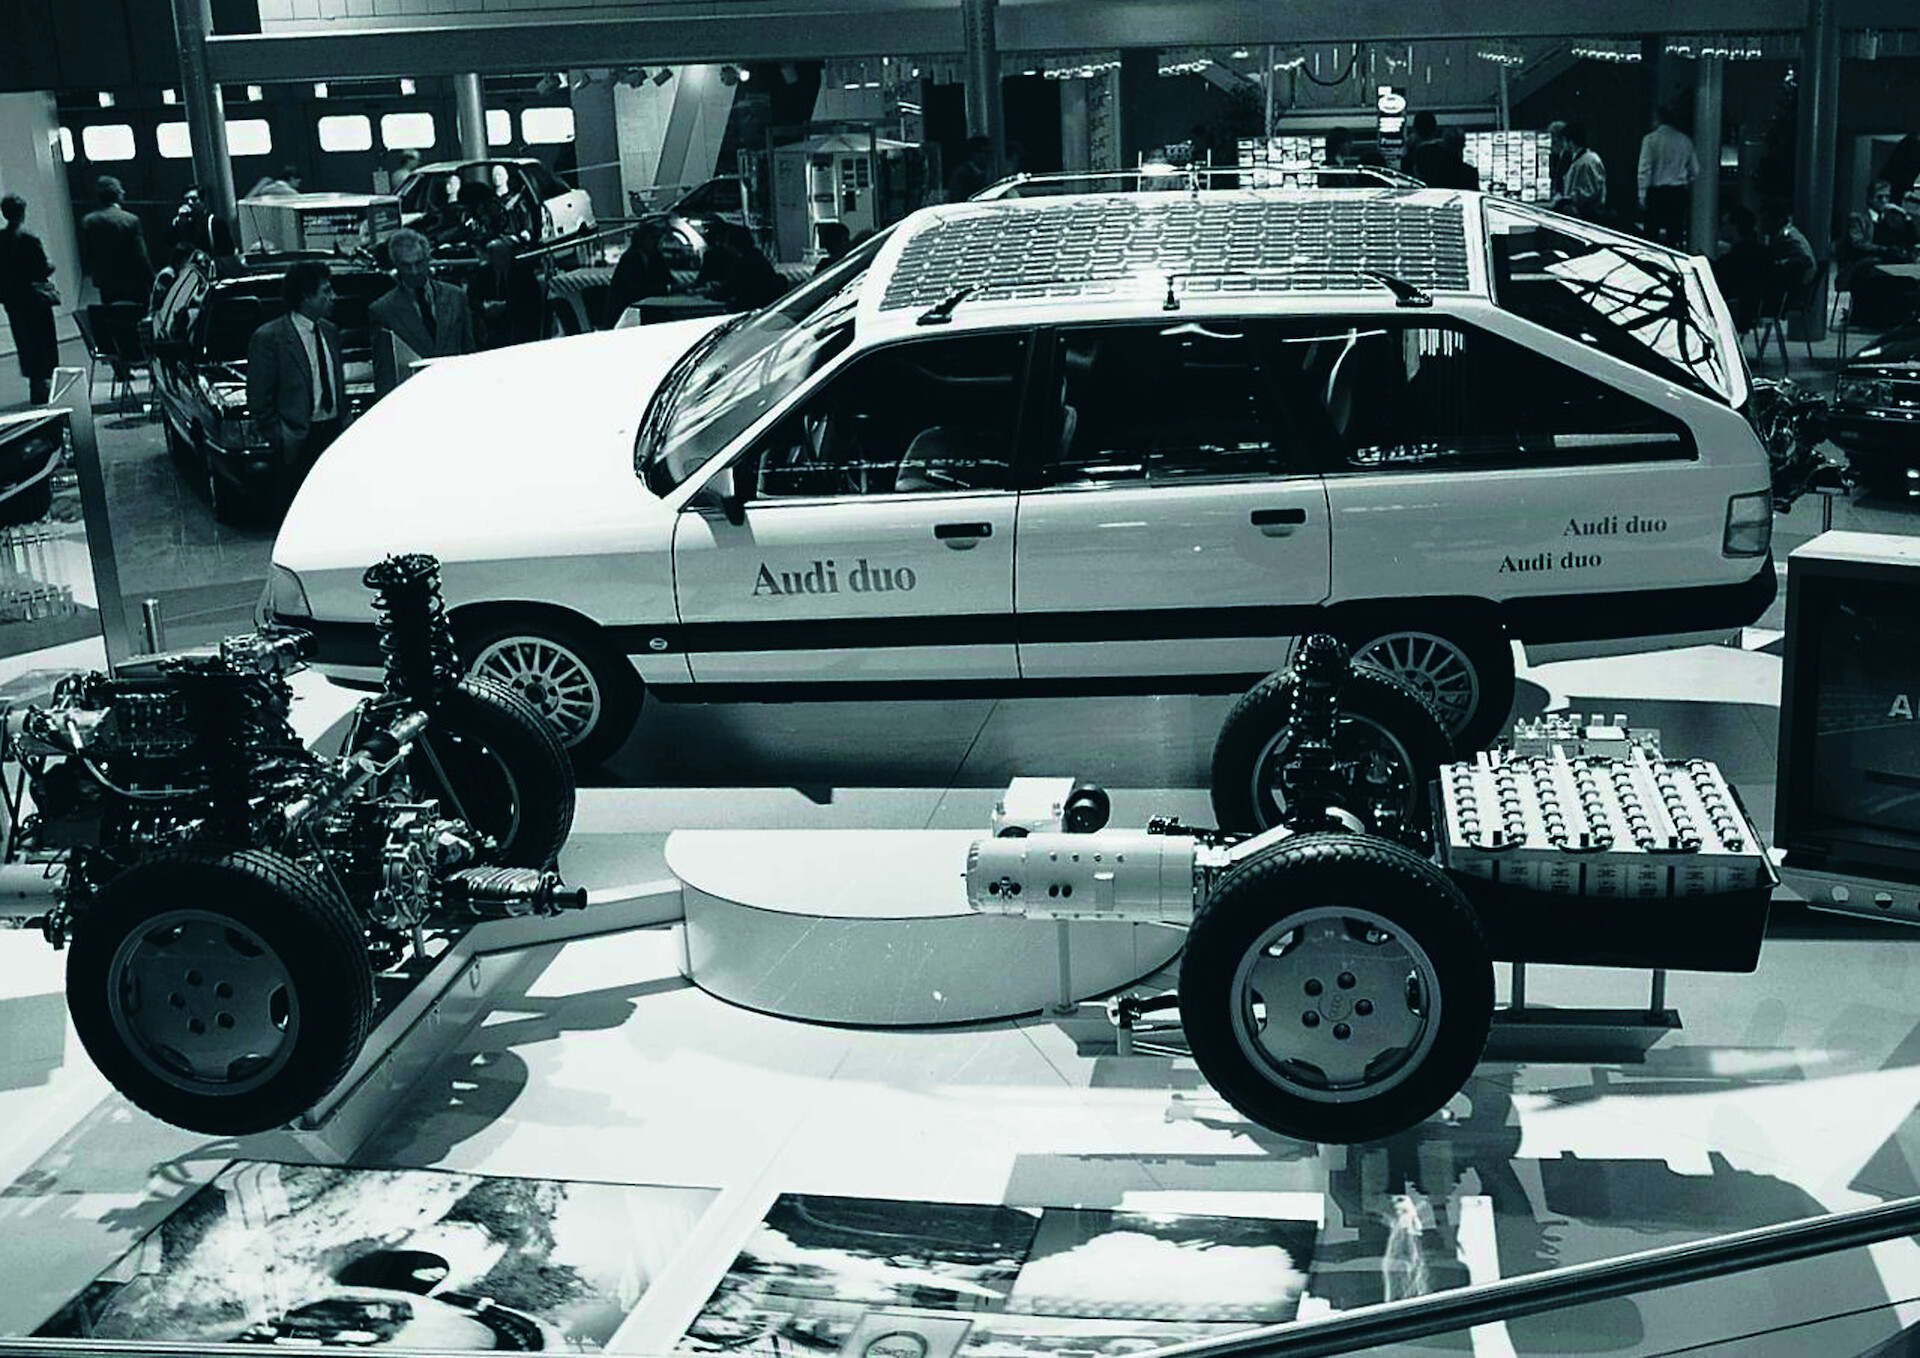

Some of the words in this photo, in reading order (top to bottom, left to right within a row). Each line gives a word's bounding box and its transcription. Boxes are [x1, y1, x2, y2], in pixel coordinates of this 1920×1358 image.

[1563, 516, 1618, 537] Audi
[1625, 515, 1668, 534] duo
[1499, 552, 1552, 574] Audi
[1560, 551, 1602, 569] duo
[752, 560, 840, 596] Audi
[848, 558, 916, 593] duo
